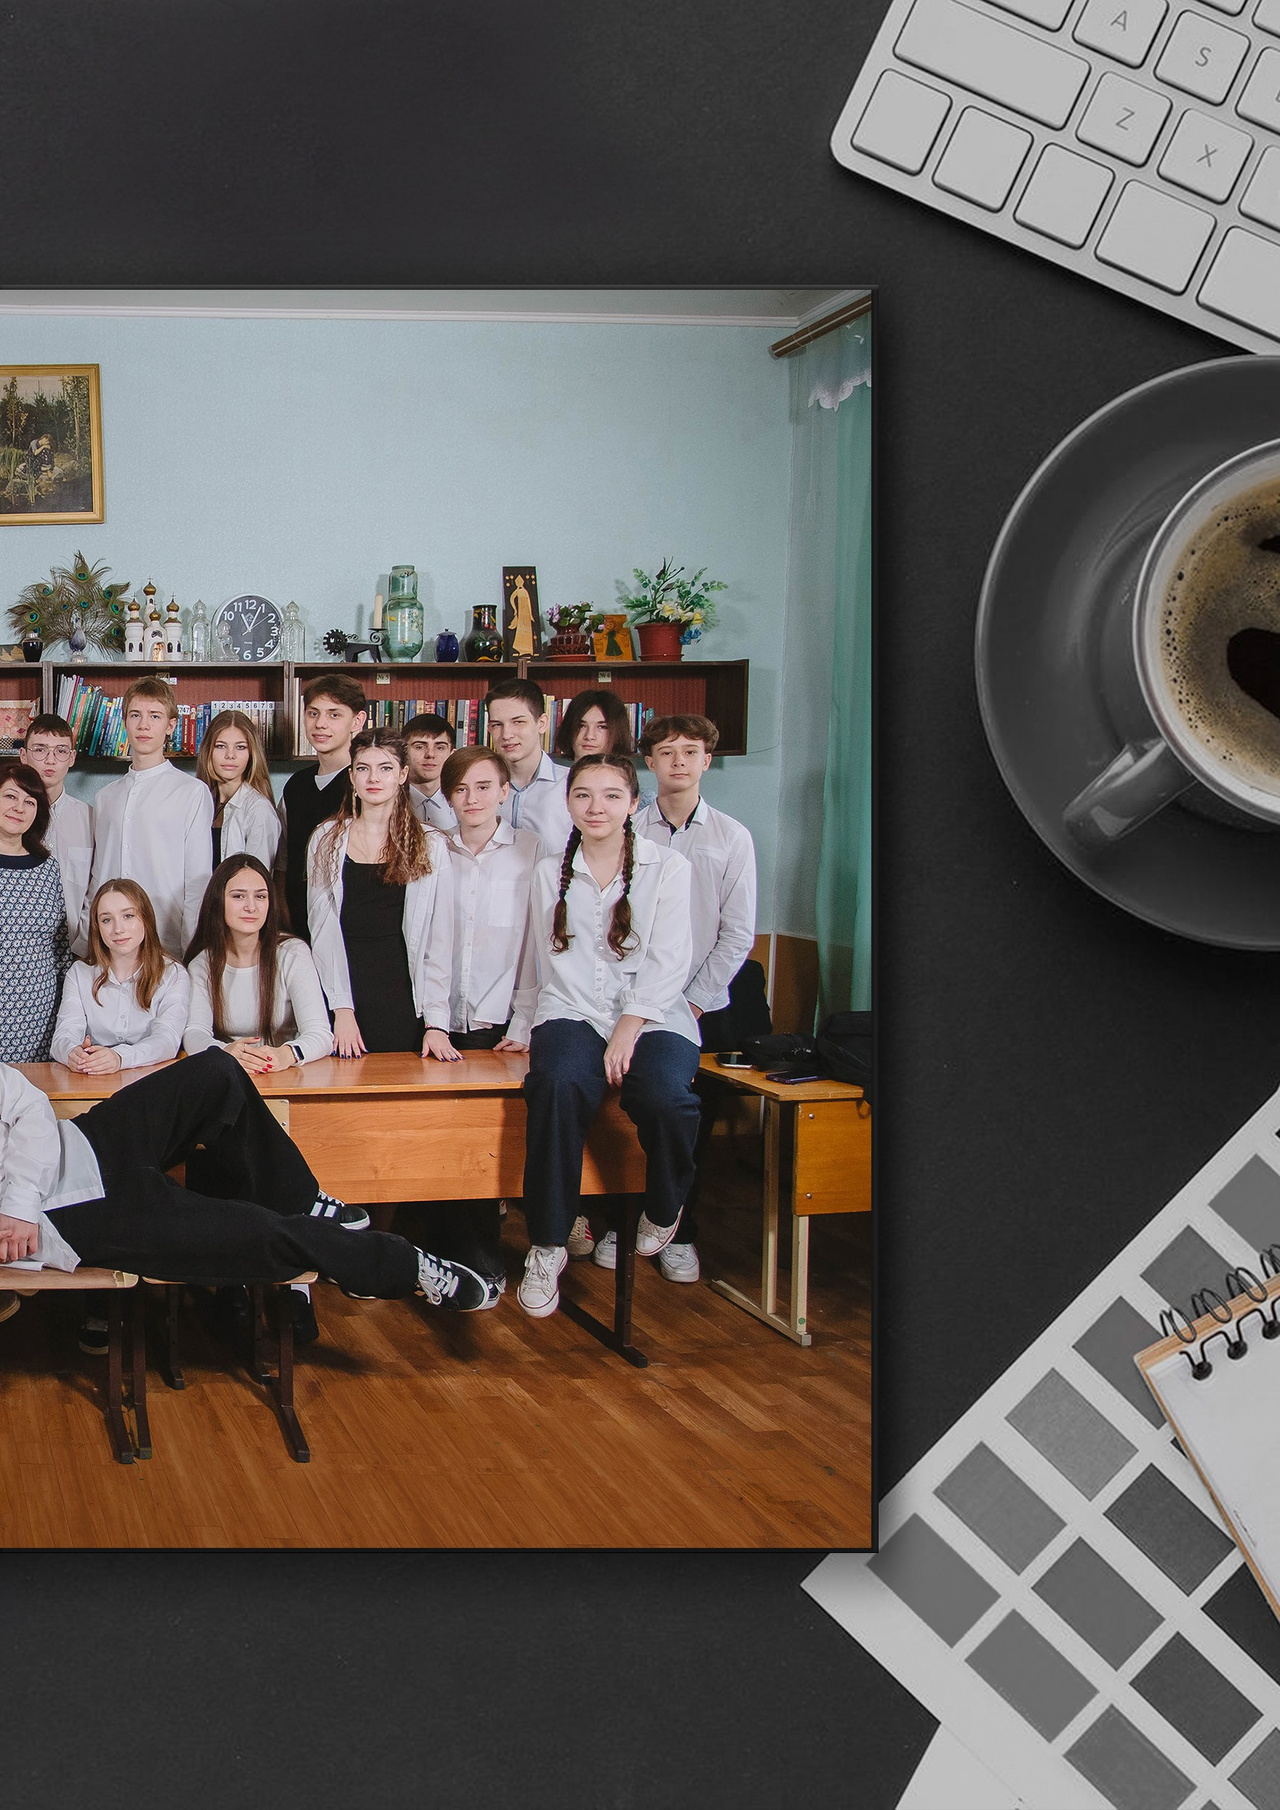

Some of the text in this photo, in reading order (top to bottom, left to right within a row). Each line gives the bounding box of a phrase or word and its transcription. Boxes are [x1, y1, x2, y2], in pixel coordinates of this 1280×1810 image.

[1110, 10, 1128, 32] A
[1194, 46, 1212, 67] S
[1115, 106, 1136, 131] Z
[1196, 144, 1218, 168] X
[233, 602, 242, 612] 11
[245, 600, 256, 609] 12
[261, 604, 266, 613] 1
[223, 611, 235, 620] 10
[268, 613, 275, 623] 2
[270, 626, 279, 636] 3
[265, 639, 274, 649] 4
[234, 647, 240, 655] 7
[243, 650, 251, 660] 6
[256, 648, 264, 657] 5
